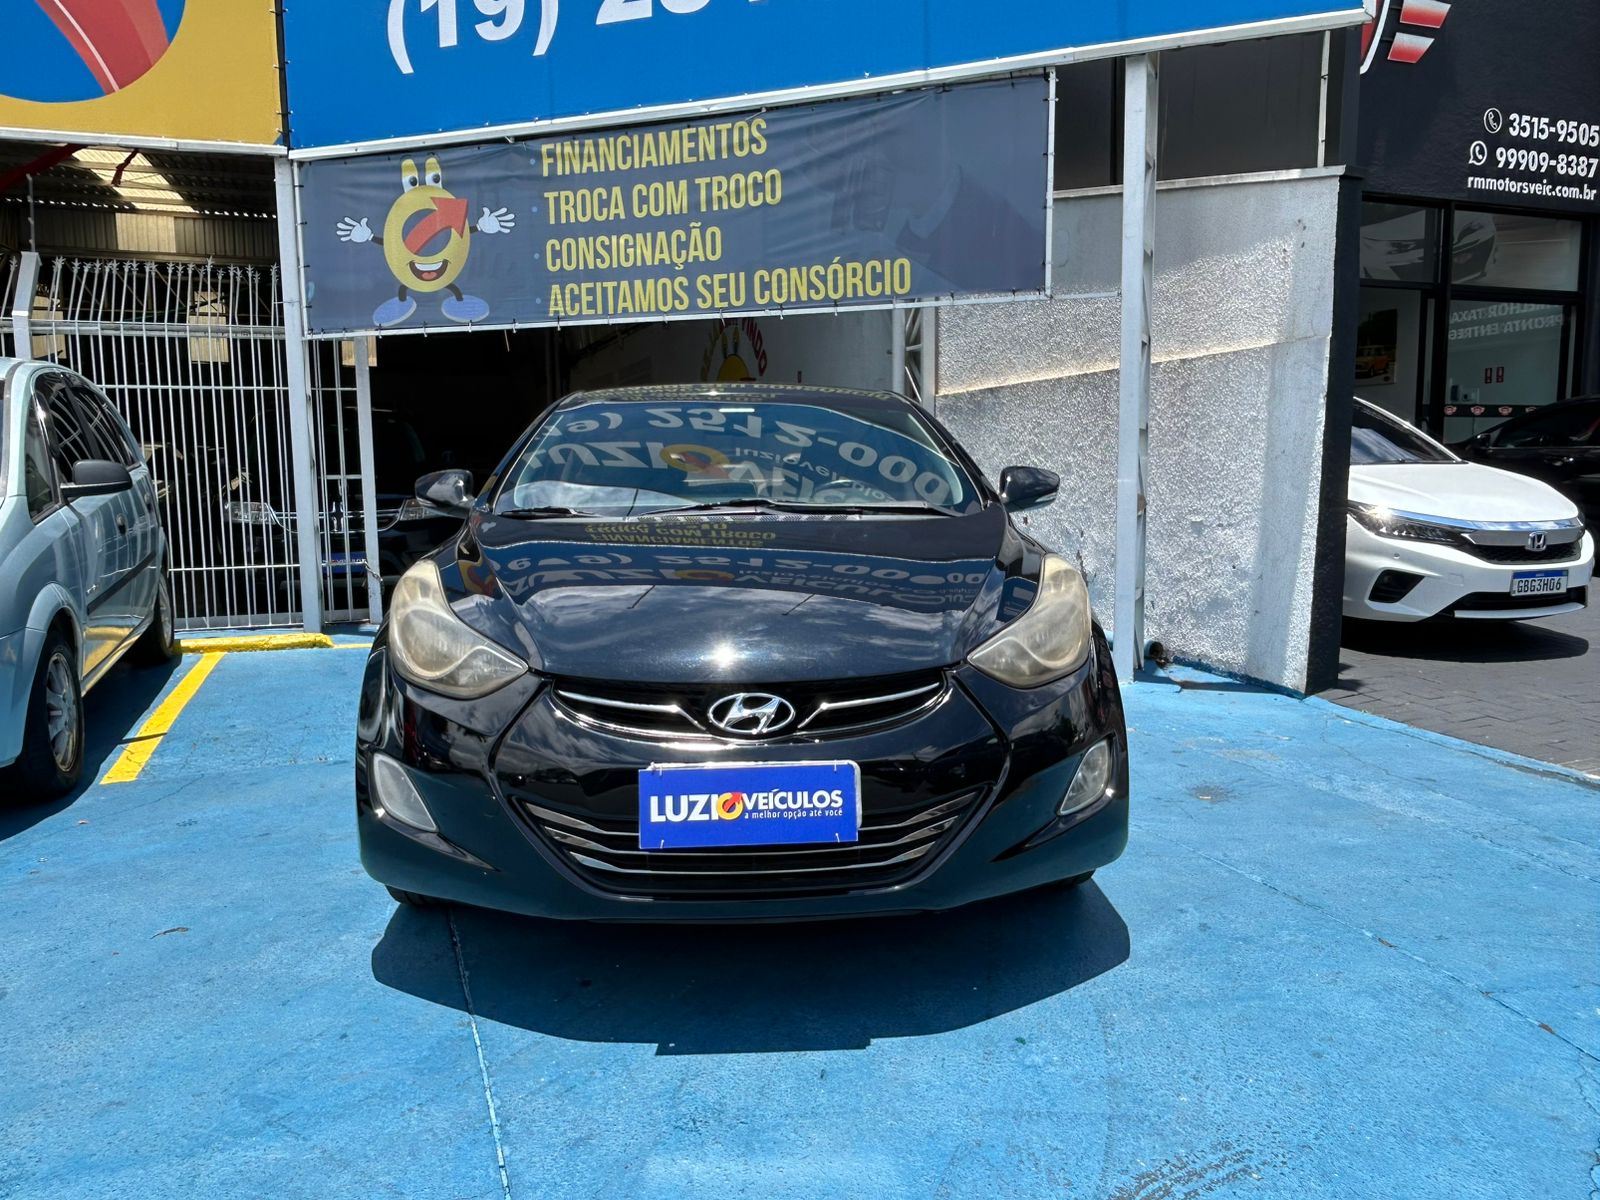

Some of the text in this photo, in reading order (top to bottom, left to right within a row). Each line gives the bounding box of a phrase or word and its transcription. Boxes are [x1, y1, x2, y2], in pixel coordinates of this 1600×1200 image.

[541, 118, 768, 177] FINANCIAMENTOS
[1508, 112, 1600, 148] 3515-9505
[1495, 147, 1600, 178] 99909-8387
[545, 169, 782, 224] TROCA COM TROCO
[1467, 175, 1597, 201] rmmotorsveic.com.br
[546, 222, 722, 272] CONSIGNAÇÃO
[549, 257, 911, 316] ACEITAMOS SEU CONSÓRCIO
[1517, 577, 1562, 593] GBG3H06
[650, 788, 843, 823] LUZIO VEÍCULOS
[744, 808, 843, 820] a melhor opção até você
